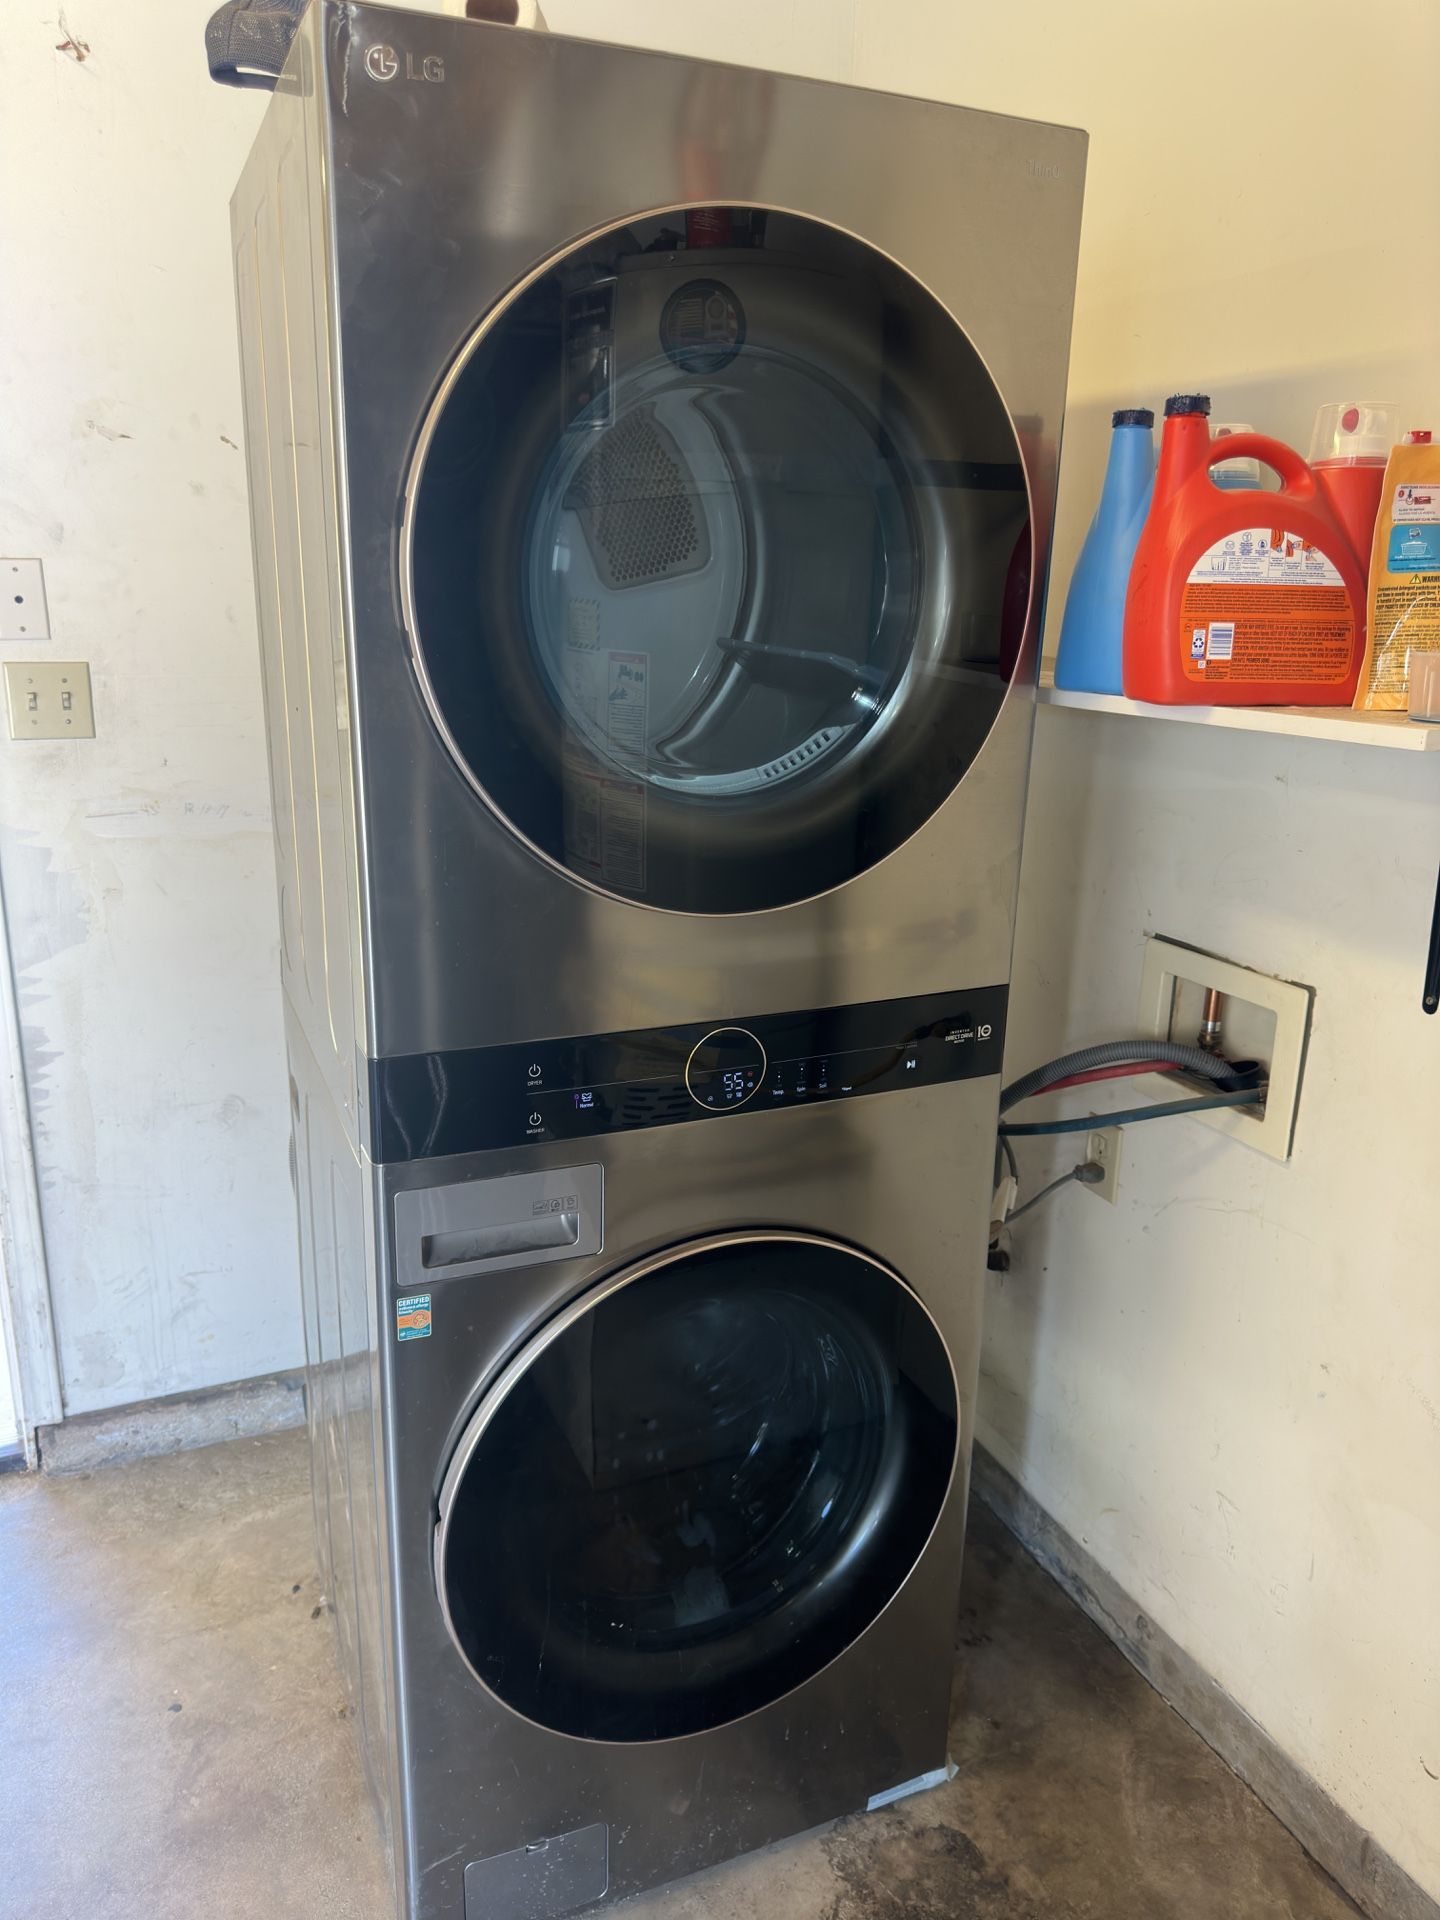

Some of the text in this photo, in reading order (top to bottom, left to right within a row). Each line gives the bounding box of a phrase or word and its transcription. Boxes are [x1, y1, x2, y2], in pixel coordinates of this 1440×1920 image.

[406, 52, 445, 82] LG
[723, 1072, 744, 1091] 55
[398, 1296, 430, 1307] CERTIFIED
